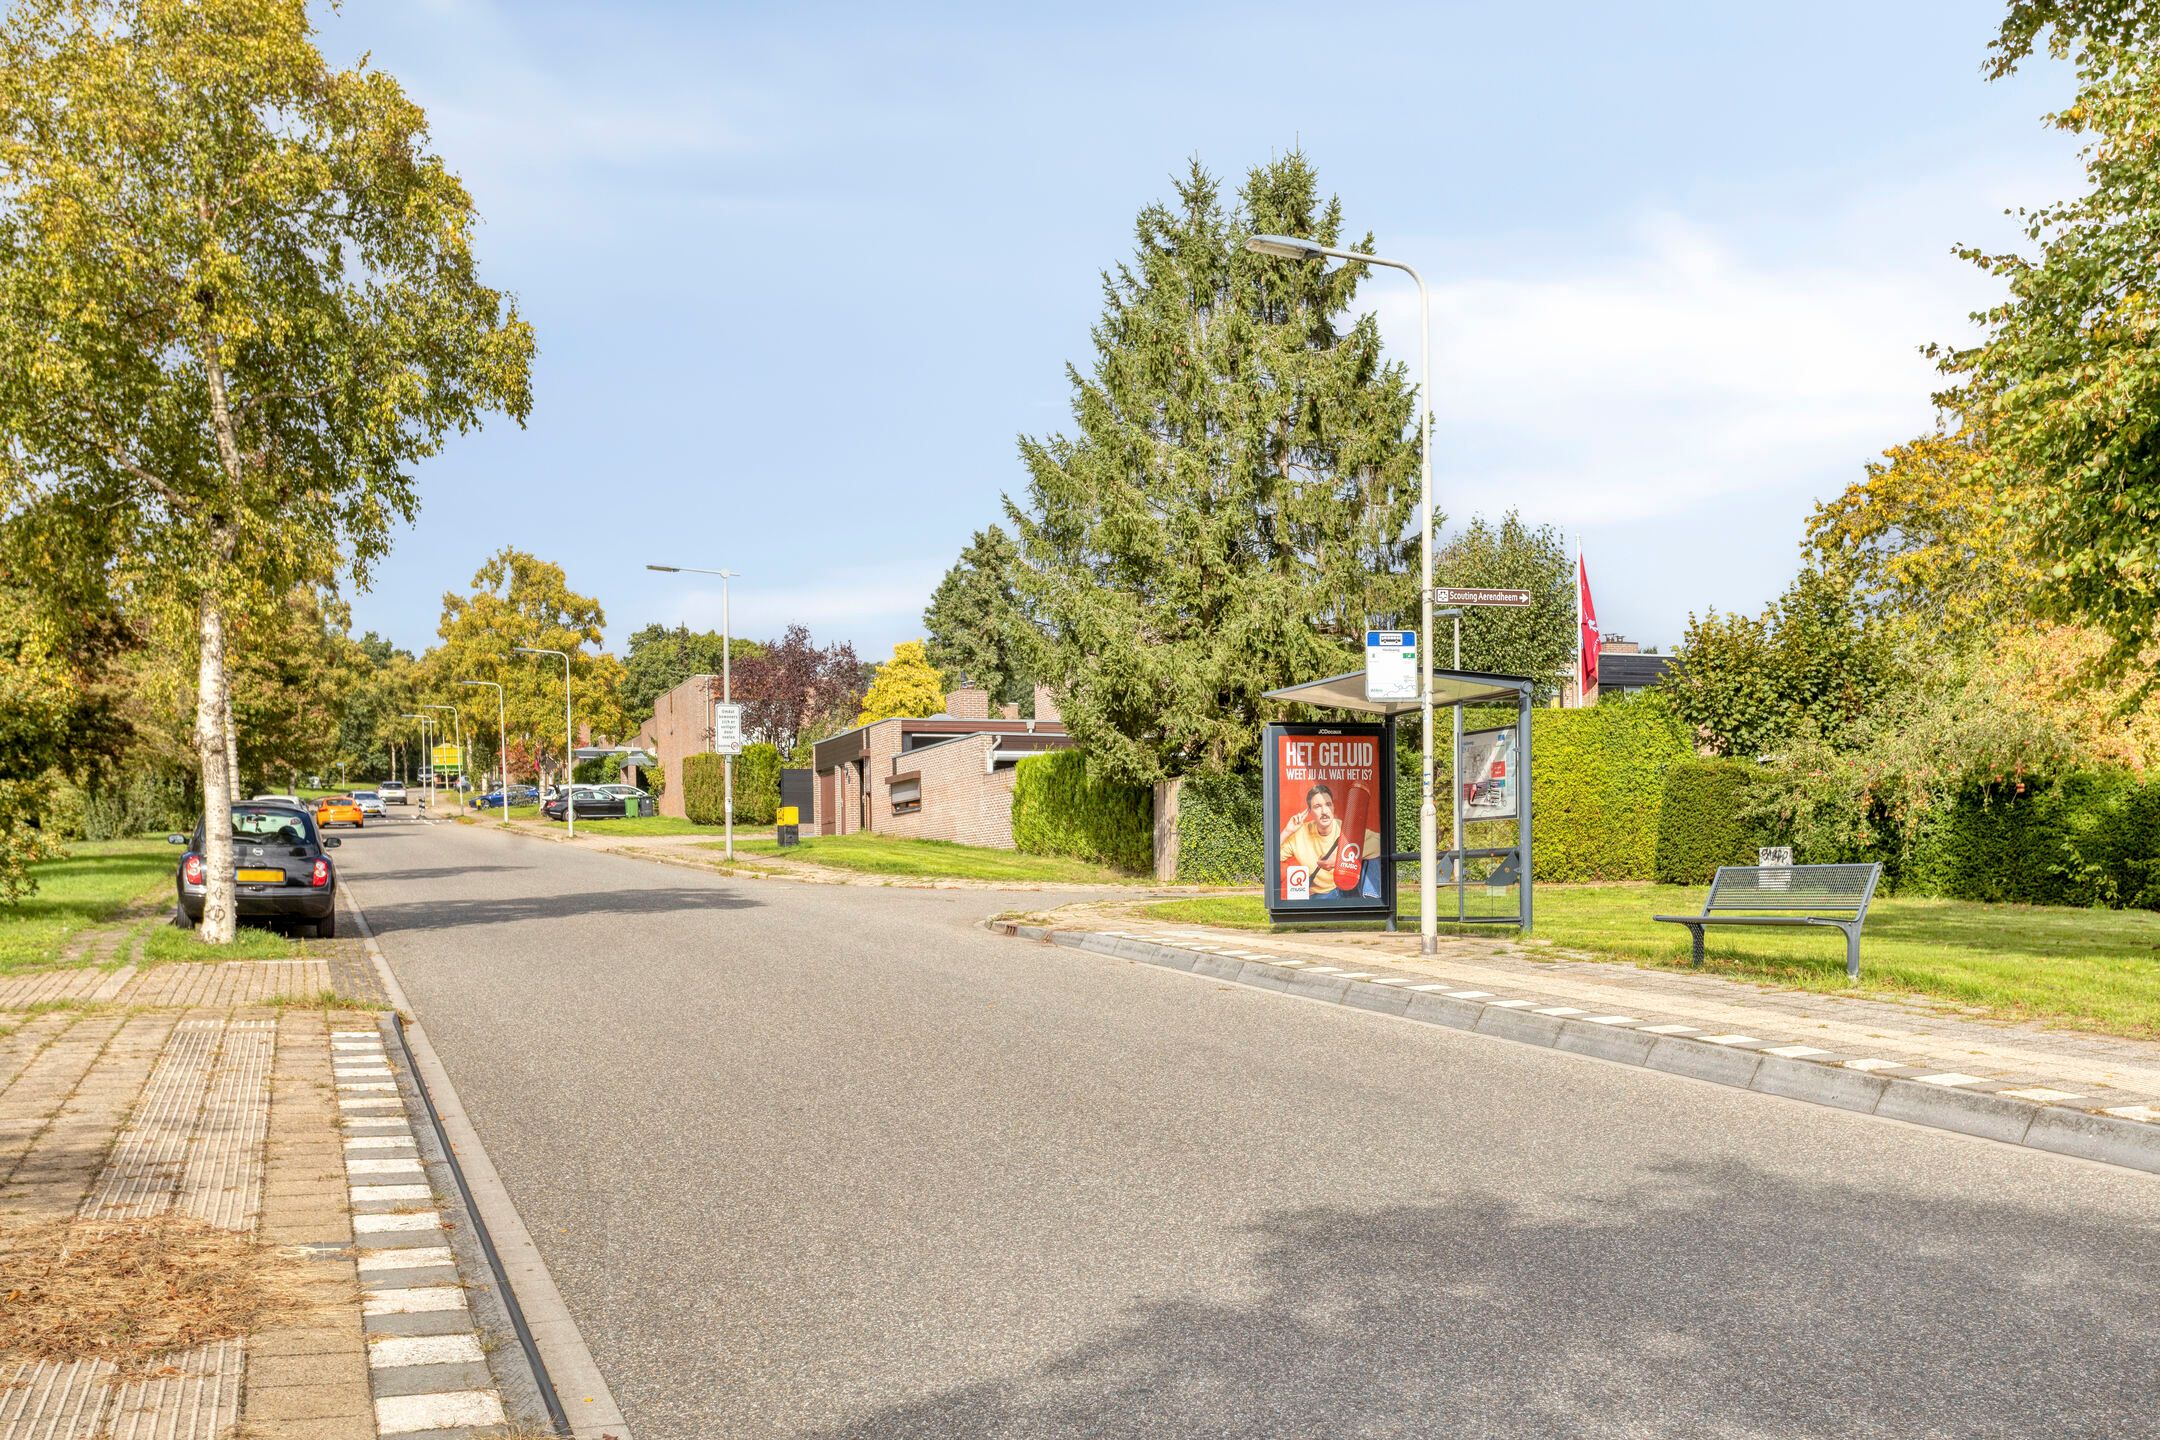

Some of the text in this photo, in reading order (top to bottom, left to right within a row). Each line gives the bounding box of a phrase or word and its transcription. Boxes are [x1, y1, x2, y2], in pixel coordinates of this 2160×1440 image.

[1449, 591, 1518, 602] Scouting Aerendheem
[1286, 741, 1373, 767] HET GELUID
[1286, 768, 1307, 780] WEET
[1318, 768, 1327, 780] AL
[1328, 768, 1345, 780] WAT
[1346, 768, 1360, 780] HET
[1361, 768, 1373, 780] IS?
[1340, 862, 1358, 870] music
